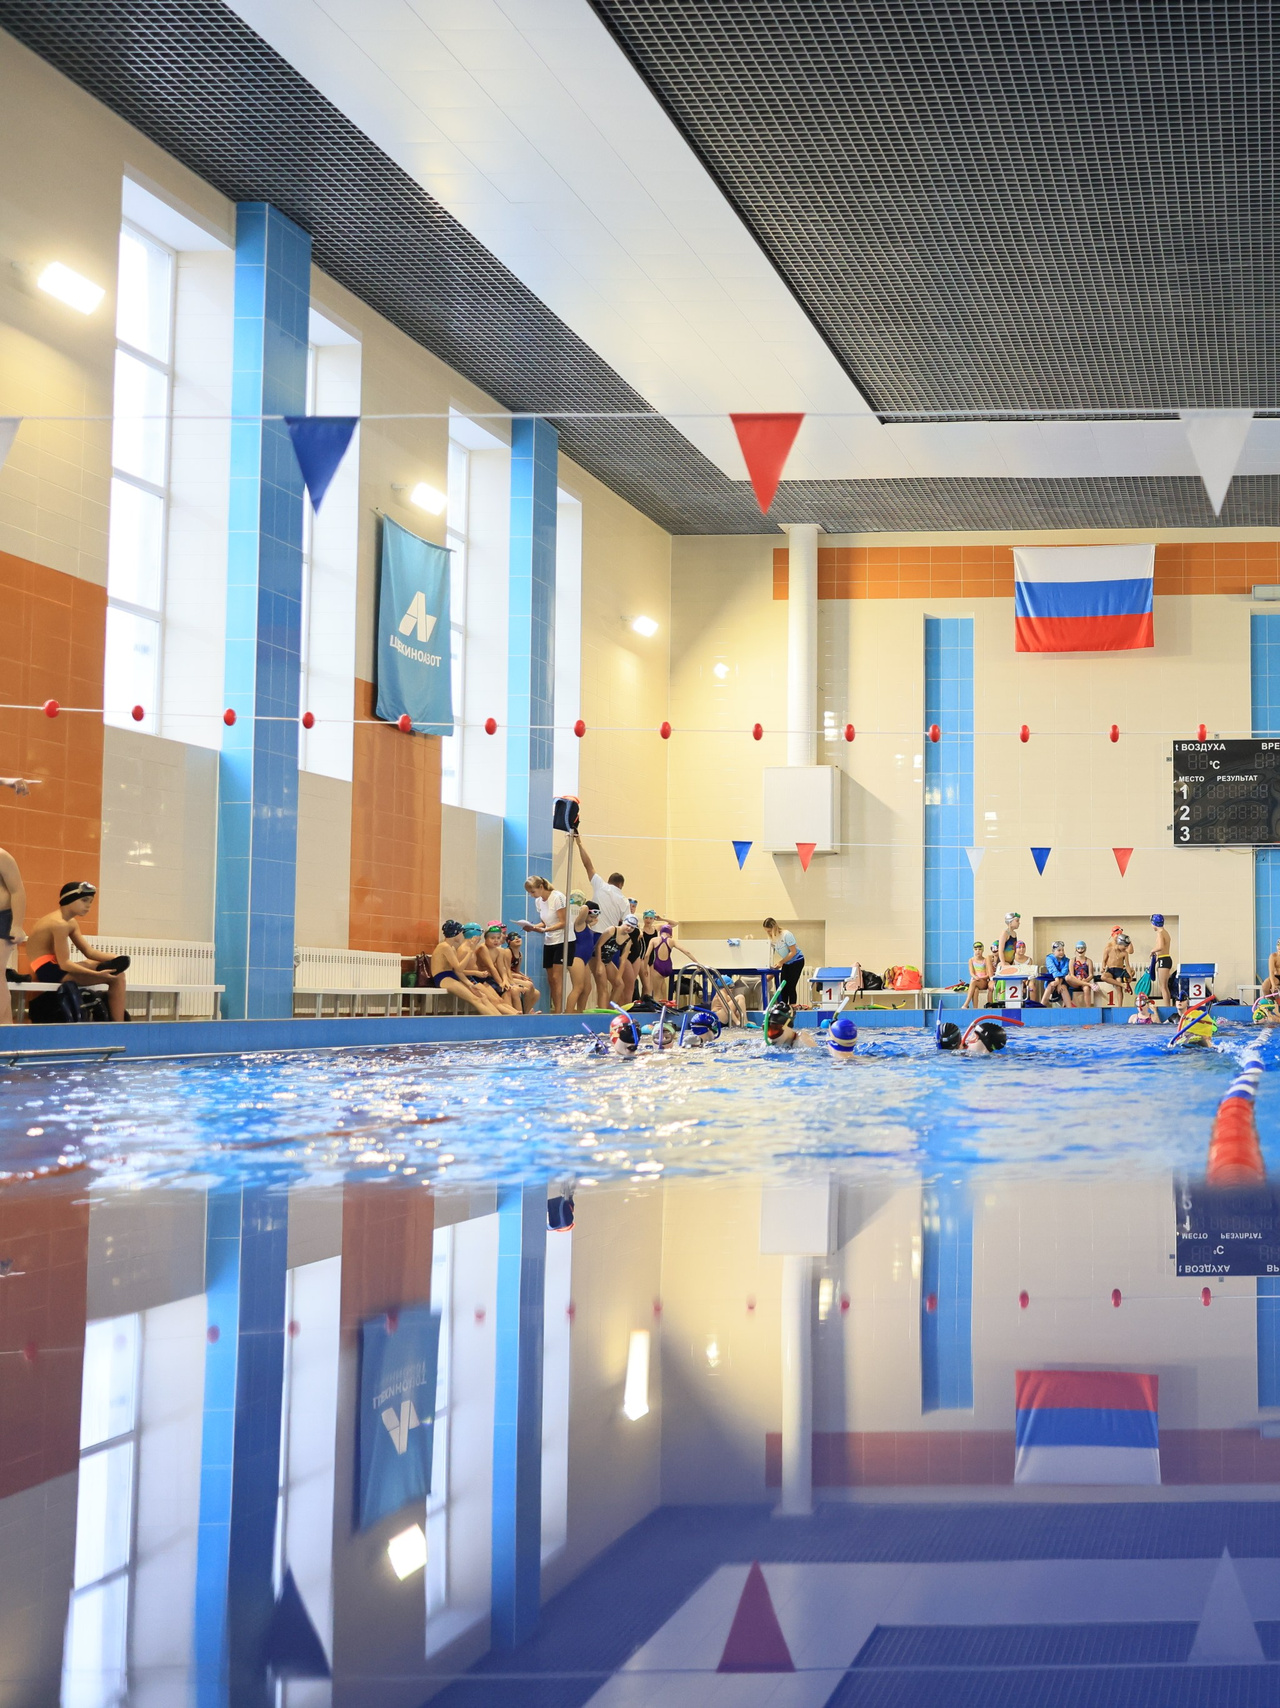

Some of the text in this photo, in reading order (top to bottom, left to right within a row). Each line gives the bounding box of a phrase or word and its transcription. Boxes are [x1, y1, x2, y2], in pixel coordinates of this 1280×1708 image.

[1181, 743, 1226, 752] ВОЗДУХА
[1216, 774, 1258, 782] РЕЗУЛЬТАТ
[1179, 785, 1189, 800] 1
[1179, 805, 1190, 820] 2
[1179, 826, 1190, 841] 3
[825, 988, 832, 1000] 1
[1009, 986, 1018, 999] 2
[1193, 984, 1202, 996] 3
[1106, 991, 1115, 1006] 1
